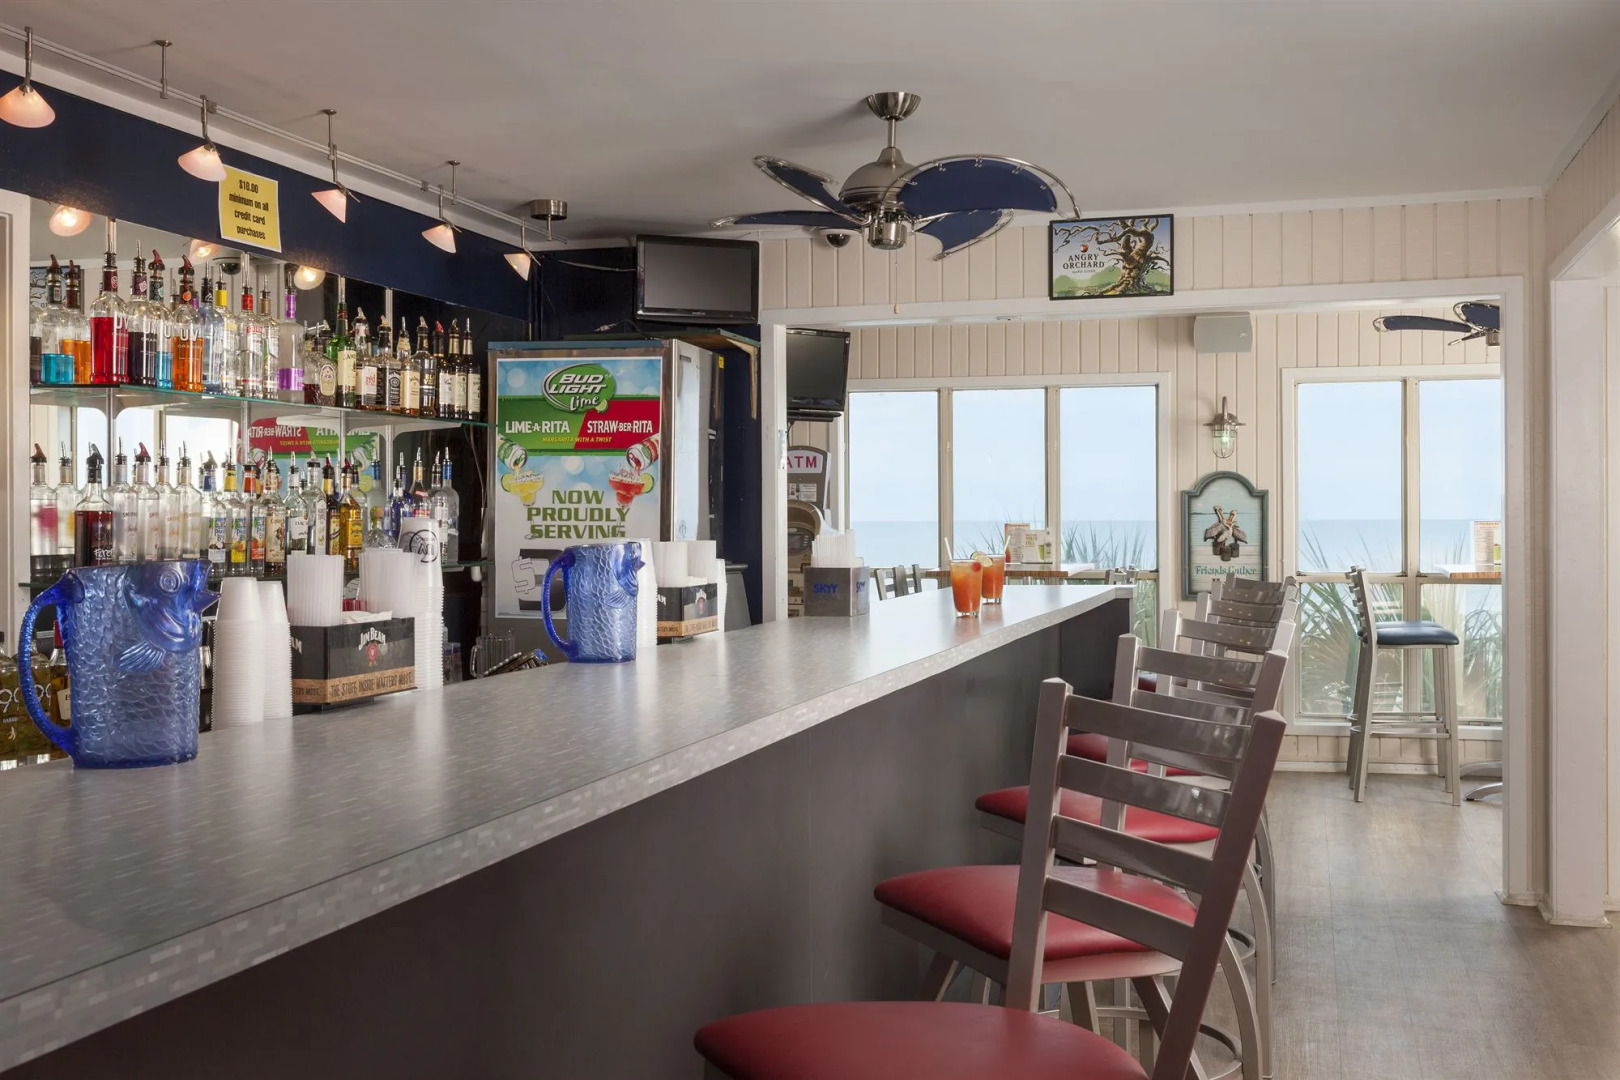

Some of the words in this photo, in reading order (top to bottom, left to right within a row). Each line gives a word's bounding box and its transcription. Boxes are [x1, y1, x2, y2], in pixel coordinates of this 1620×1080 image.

[239, 180, 259, 194] $10.00
[229, 192, 253, 207] minimum
[254, 200, 262, 209] on
[234, 210, 251, 222] credit
[252, 215, 266, 225] card
[236, 226, 266, 240] purchases
[1068, 253, 1099, 262] ANGRY
[1062, 260, 1105, 270] ORCHARD
[559, 373, 604, 384] BUD
[548, 384, 606, 394] LIGHT
[551, 490, 605, 504] NOW
[527, 507, 630, 522] PROUDLY
[530, 524, 626, 539] SERVING
[1195, 565, 1227, 576] Friends
[1228, 565, 1257, 576] Gather
[813, 583, 838, 594] SKYY
[358, 631, 371, 651] JIM
[370, 627, 386, 646] BEAM
[331, 685, 340, 698] THE
[341, 682, 357, 696] STUFF
[359, 678, 375, 691] INSIDE
[376, 675, 398, 688] MATTERS
